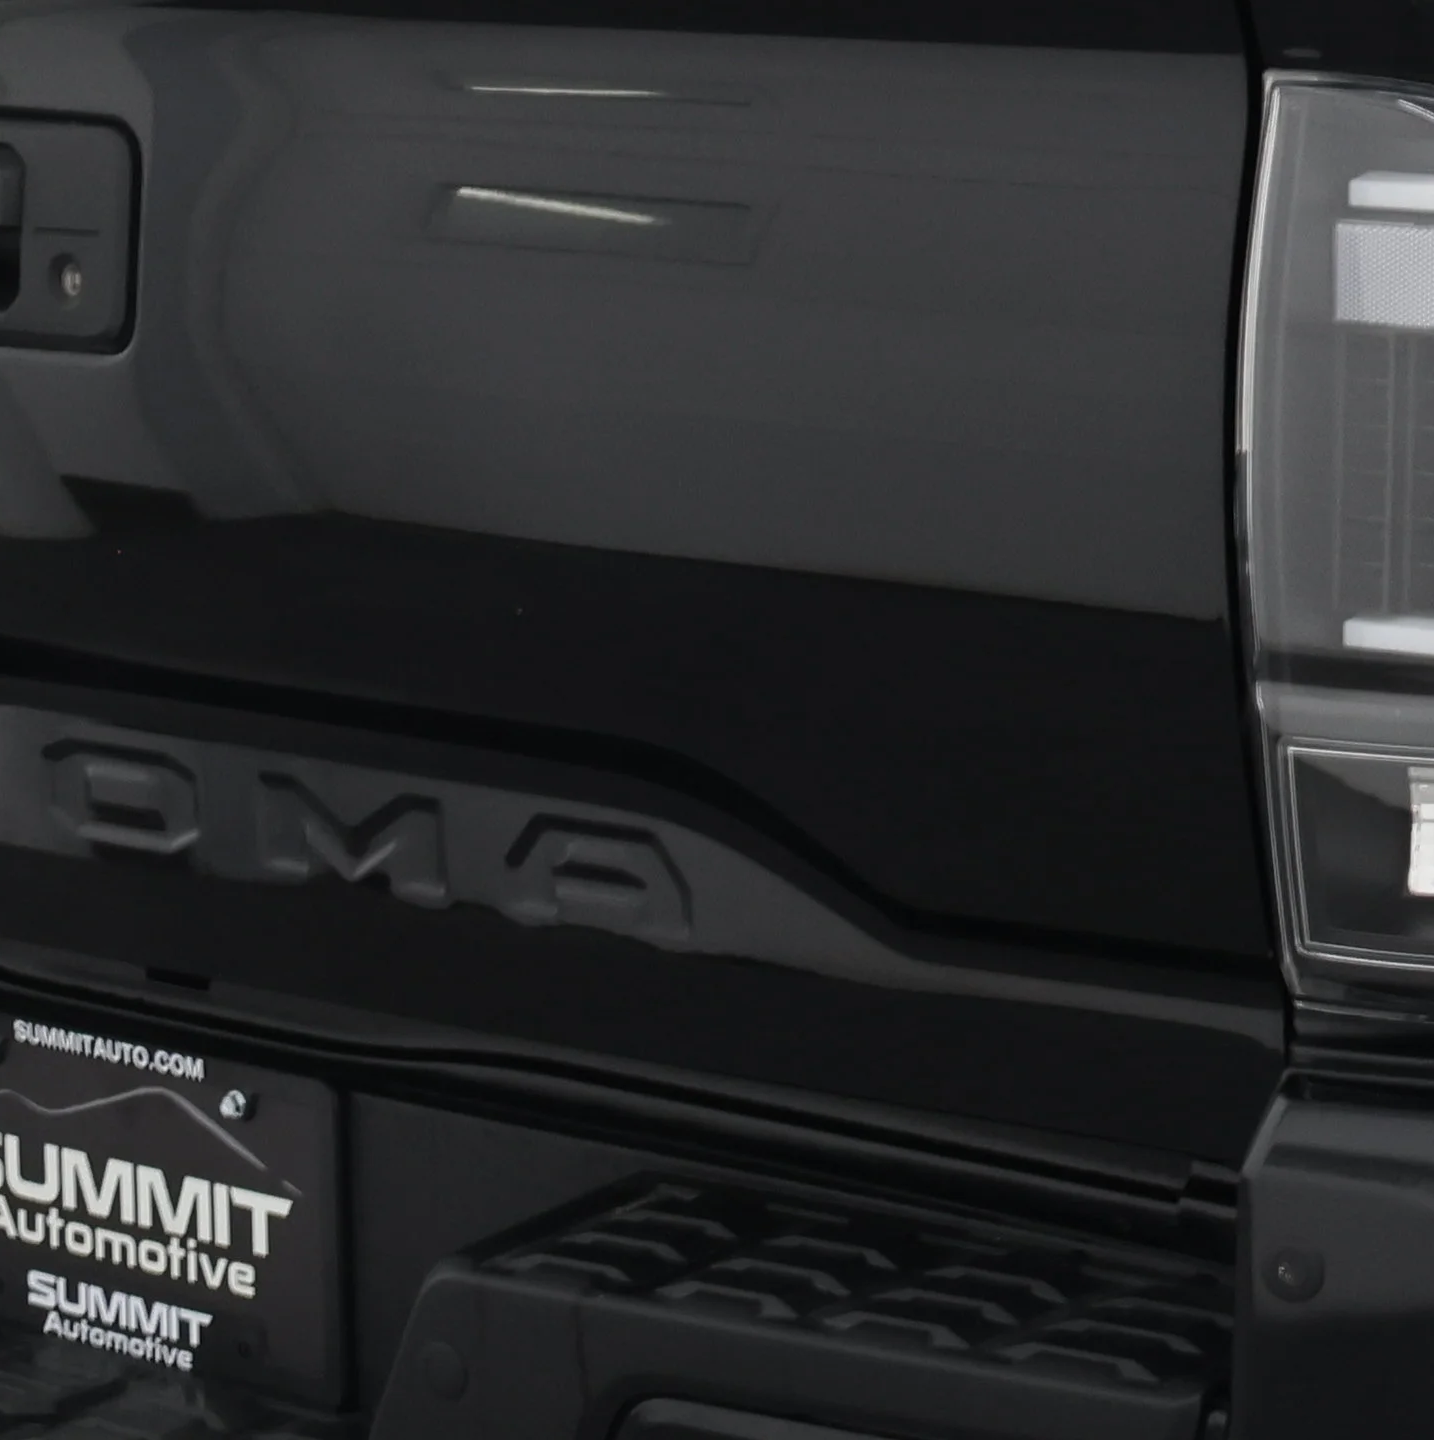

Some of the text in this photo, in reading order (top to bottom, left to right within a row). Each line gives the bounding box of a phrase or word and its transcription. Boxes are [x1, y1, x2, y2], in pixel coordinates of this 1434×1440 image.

[12, 1018, 206, 1083] SUMMITAUTO.COM
[26, 1268, 213, 1348] SUMMIT
[42, 1309, 194, 1372] Automotive
